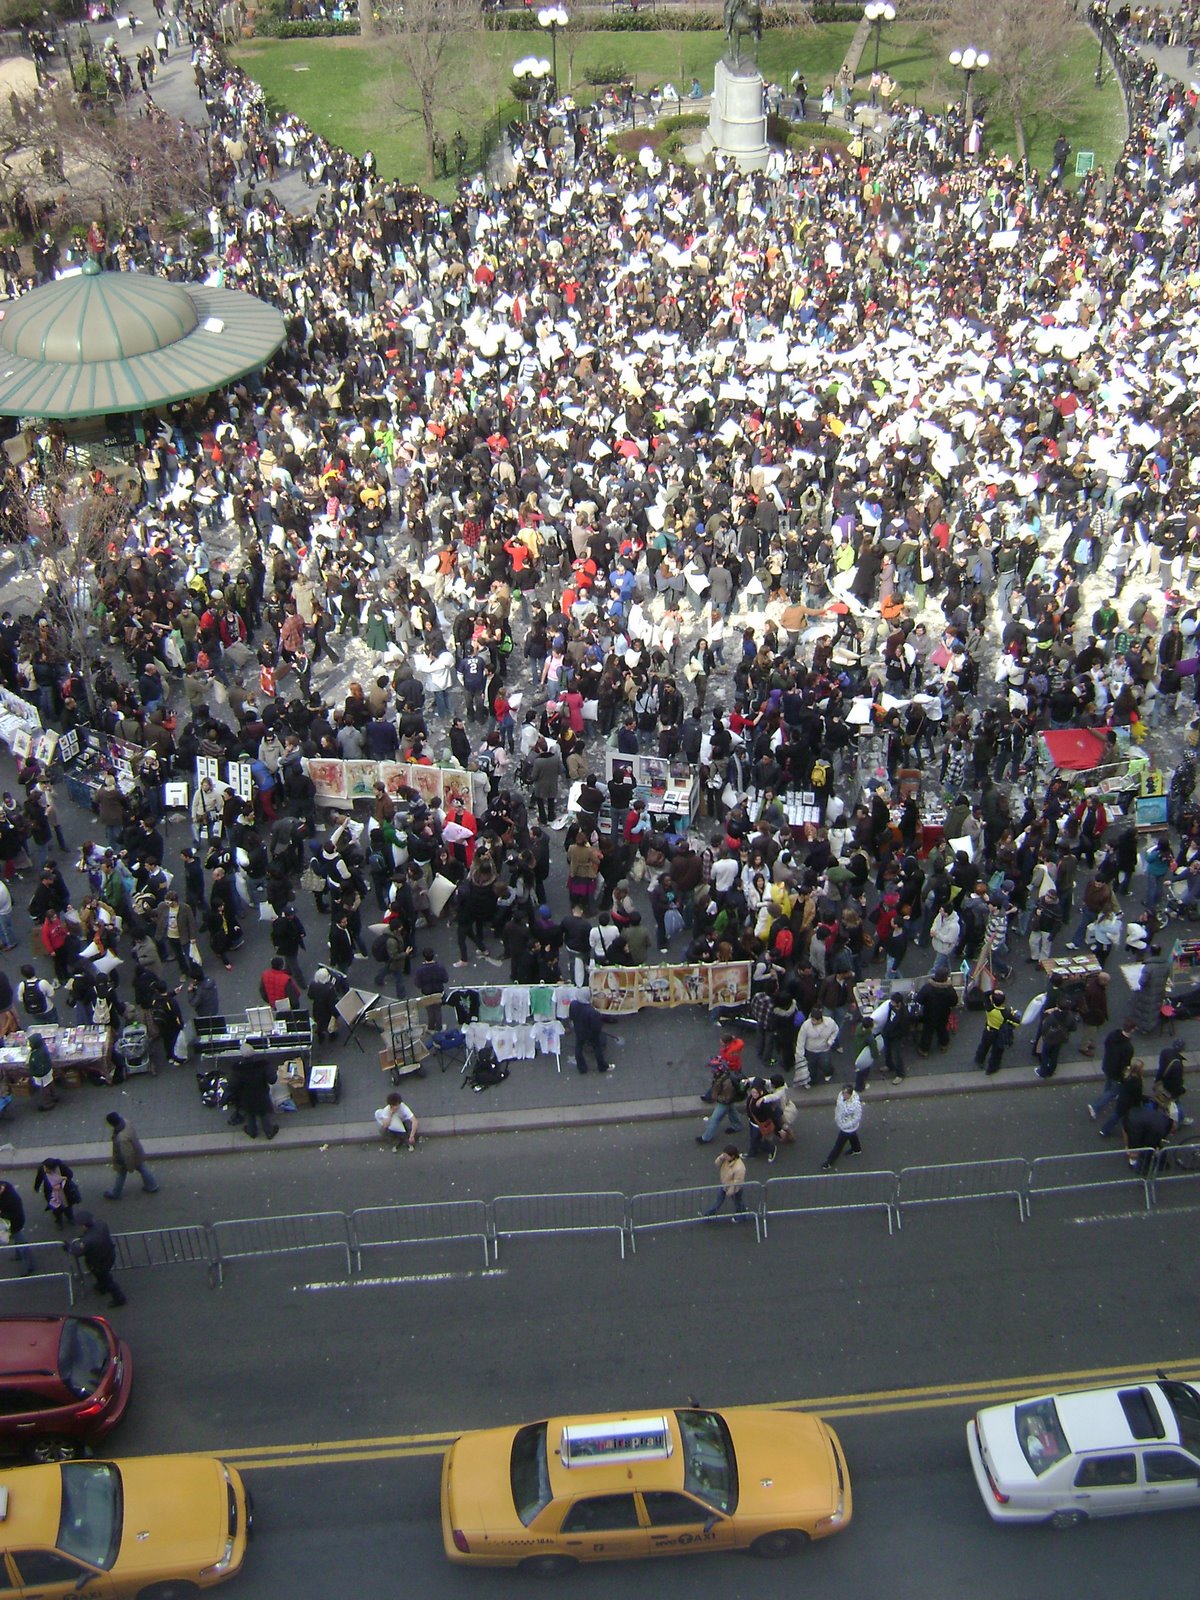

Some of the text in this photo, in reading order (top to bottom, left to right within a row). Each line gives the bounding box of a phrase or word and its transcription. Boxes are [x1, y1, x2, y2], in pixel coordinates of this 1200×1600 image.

[470, 662, 477, 673] 2
[217, 852, 231, 864] 10
[678, 1532, 716, 1545] TAXI
